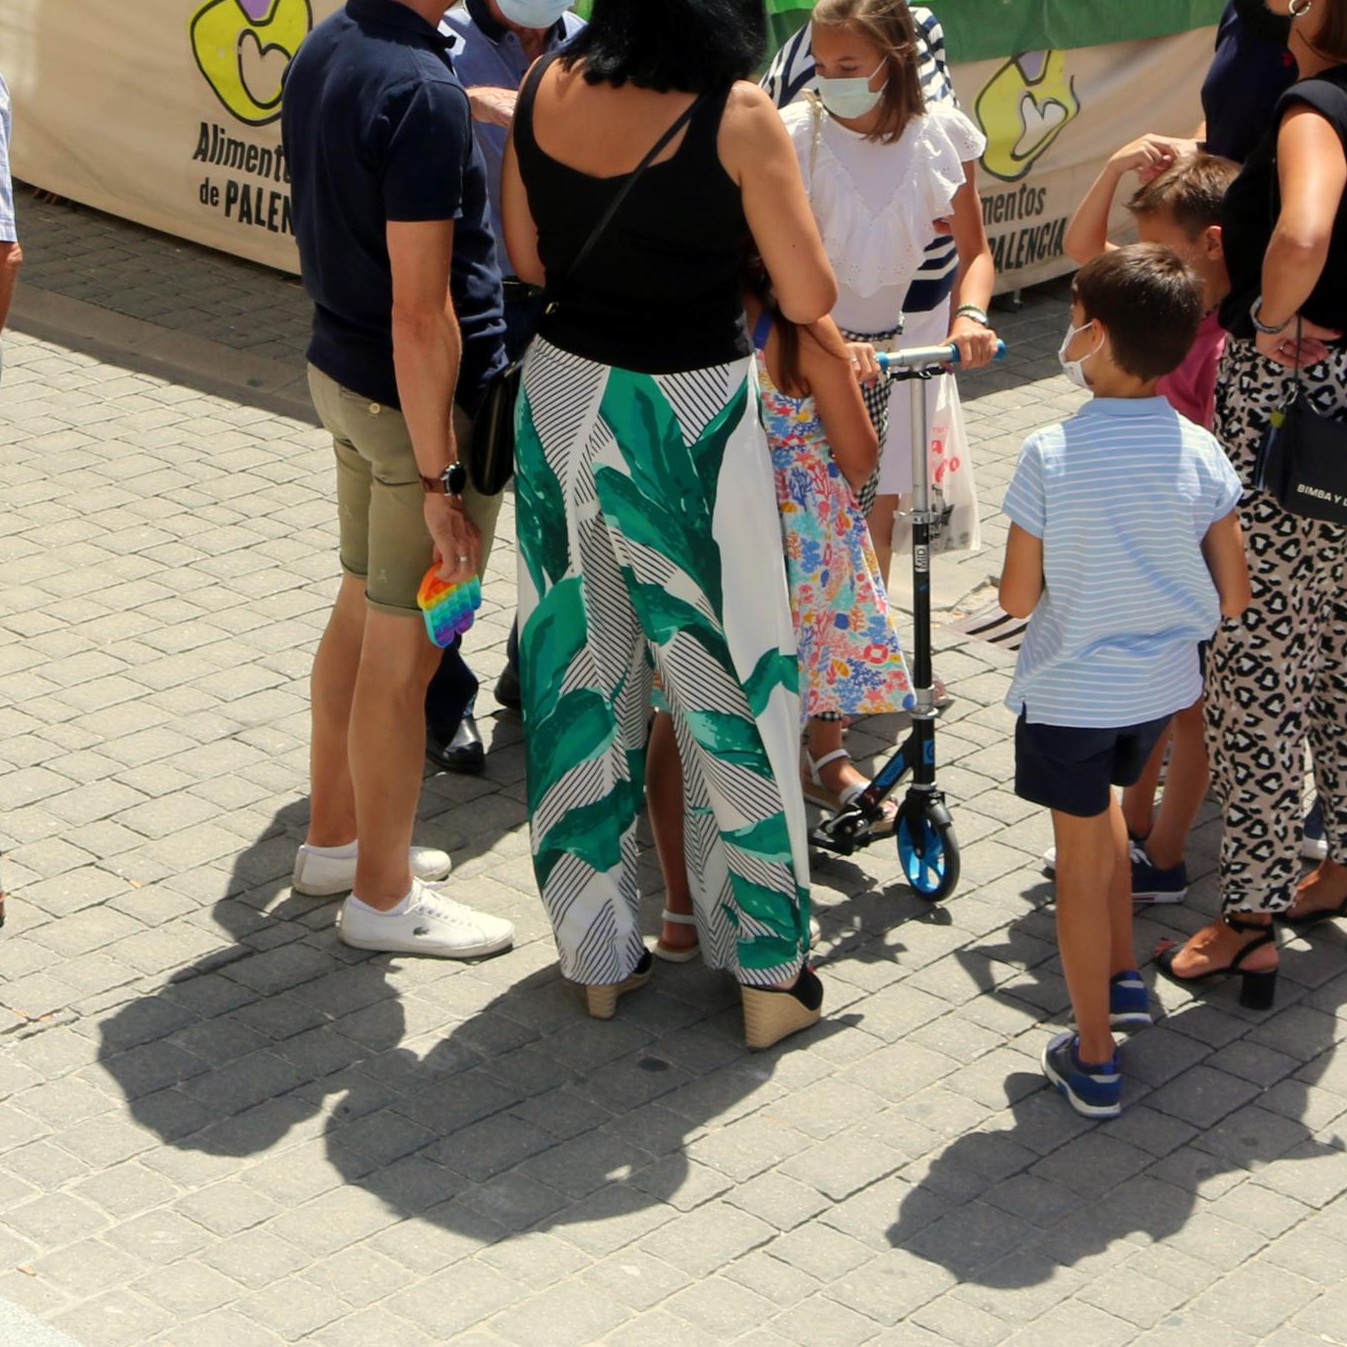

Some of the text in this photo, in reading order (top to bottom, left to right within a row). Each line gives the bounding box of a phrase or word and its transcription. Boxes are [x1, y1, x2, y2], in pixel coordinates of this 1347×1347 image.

[199, 177, 296, 237] de PALEN
[980, 182, 1047, 227] mentos
[1297, 483, 1332, 502] BIMBA
[1334, 493, 1342, 505] Y
